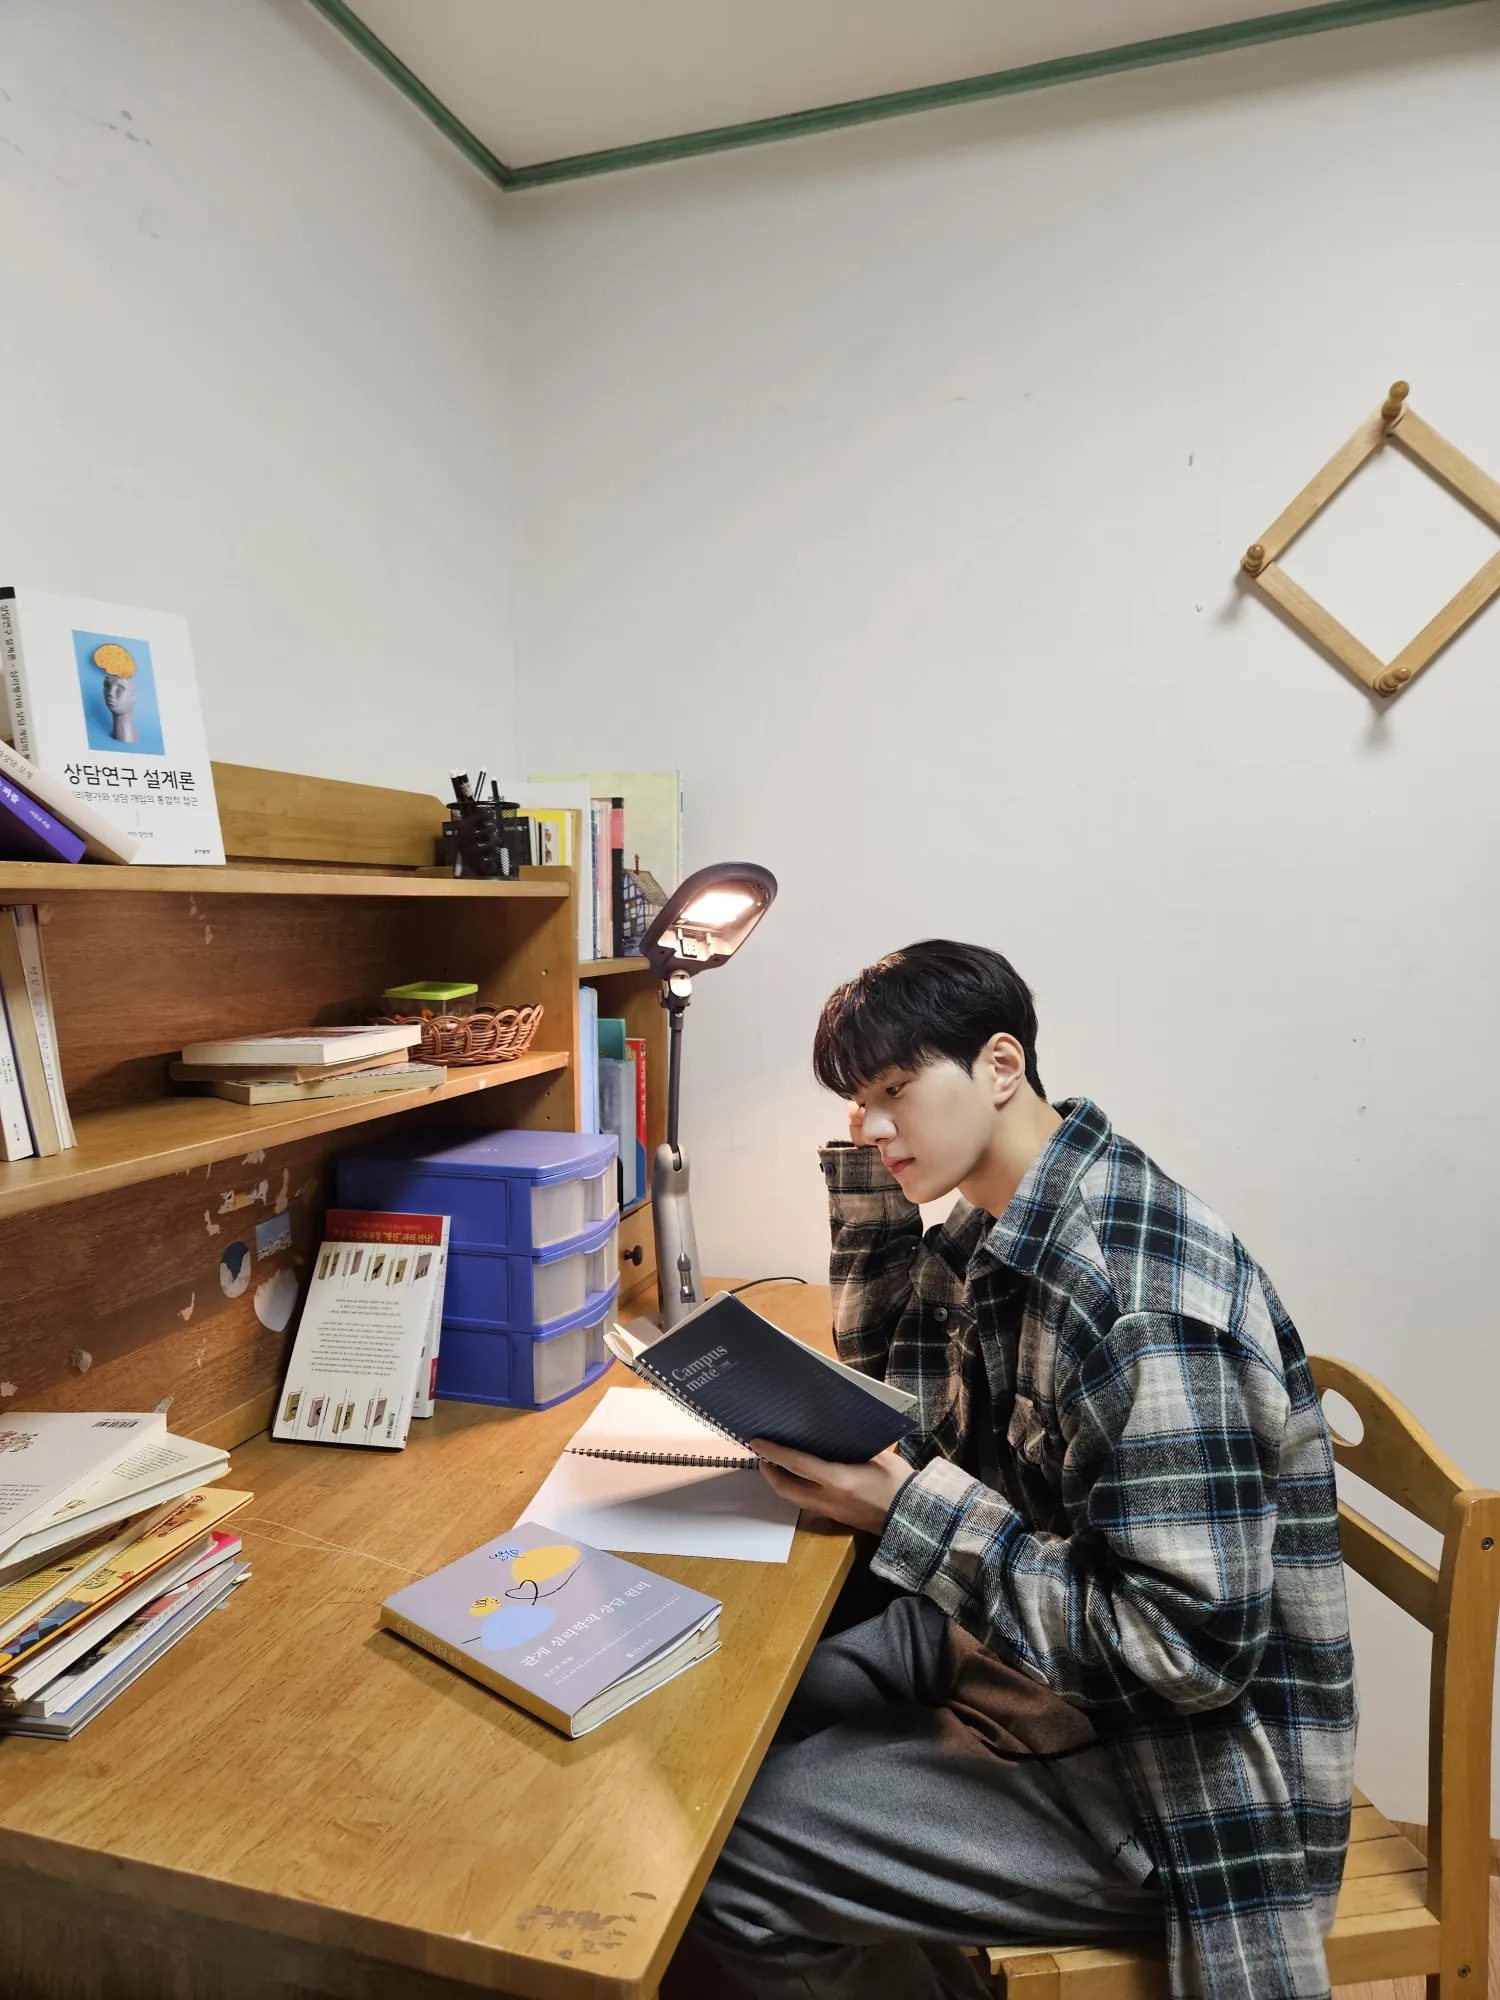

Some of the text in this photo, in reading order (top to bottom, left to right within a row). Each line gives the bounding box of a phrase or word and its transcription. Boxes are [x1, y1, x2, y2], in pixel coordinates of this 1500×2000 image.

[63, 763, 196, 791] 상담연구 설계론
[112, 793, 129, 804] 상담
[131, 794, 155, 805] 개입의
[156, 795, 180, 806] 통합적
[180, 796, 198, 807] 접근
[671, 1345, 728, 1381] Campus
[685, 1368, 720, 1392] mate
[520, 1580, 651, 1668] 관계 심리학의 상담 원리
